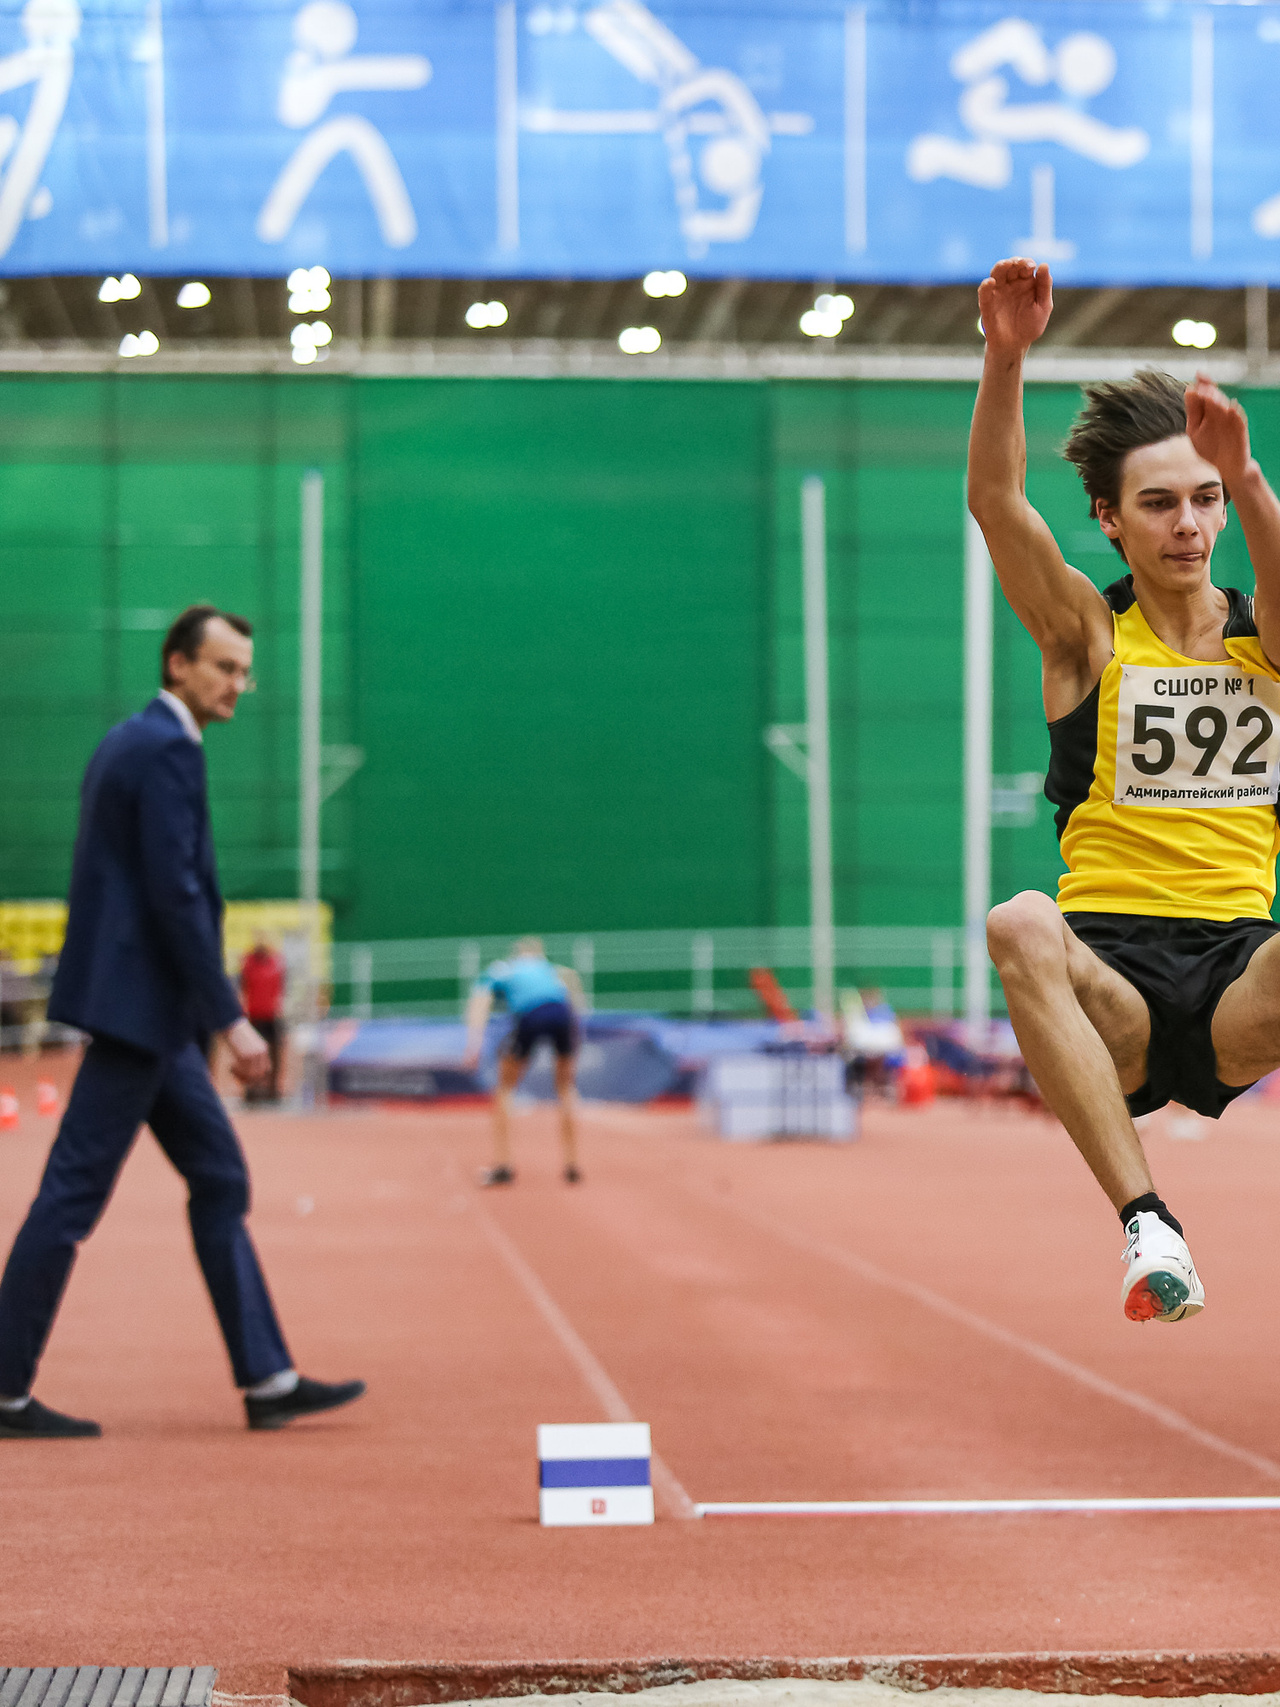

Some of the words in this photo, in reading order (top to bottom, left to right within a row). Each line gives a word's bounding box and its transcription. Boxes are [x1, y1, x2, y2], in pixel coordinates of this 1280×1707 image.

[1154, 678, 1218, 697] СШОР
[1224, 678, 1242, 696] №
[1247, 678, 1255, 696] 1
[1131, 704, 1274, 776] 592
[1125, 785, 1234, 800] Адмиралтейский
[1237, 785, 1270, 800] район
